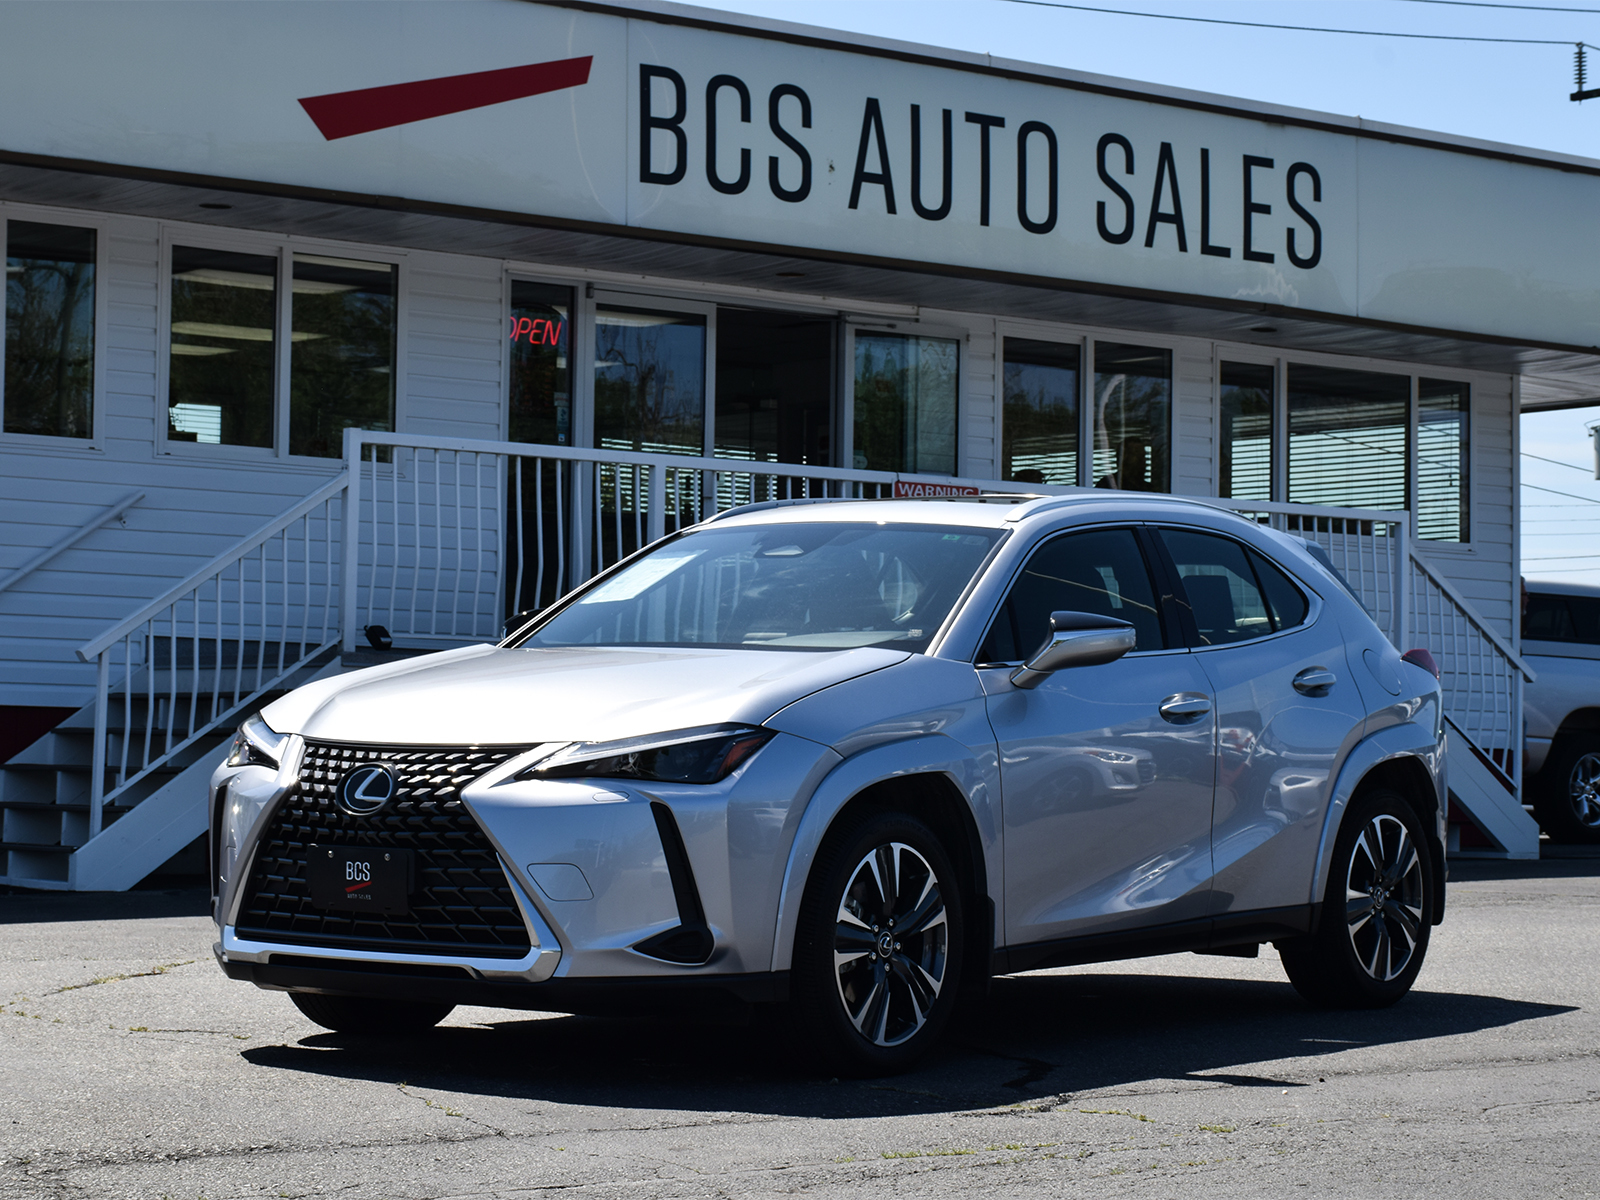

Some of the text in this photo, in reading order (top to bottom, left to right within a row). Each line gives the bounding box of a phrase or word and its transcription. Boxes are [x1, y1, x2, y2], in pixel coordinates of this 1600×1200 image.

[639, 63, 1322, 269] BCS AUTO SALES
[345, 861, 371, 881] BCS
